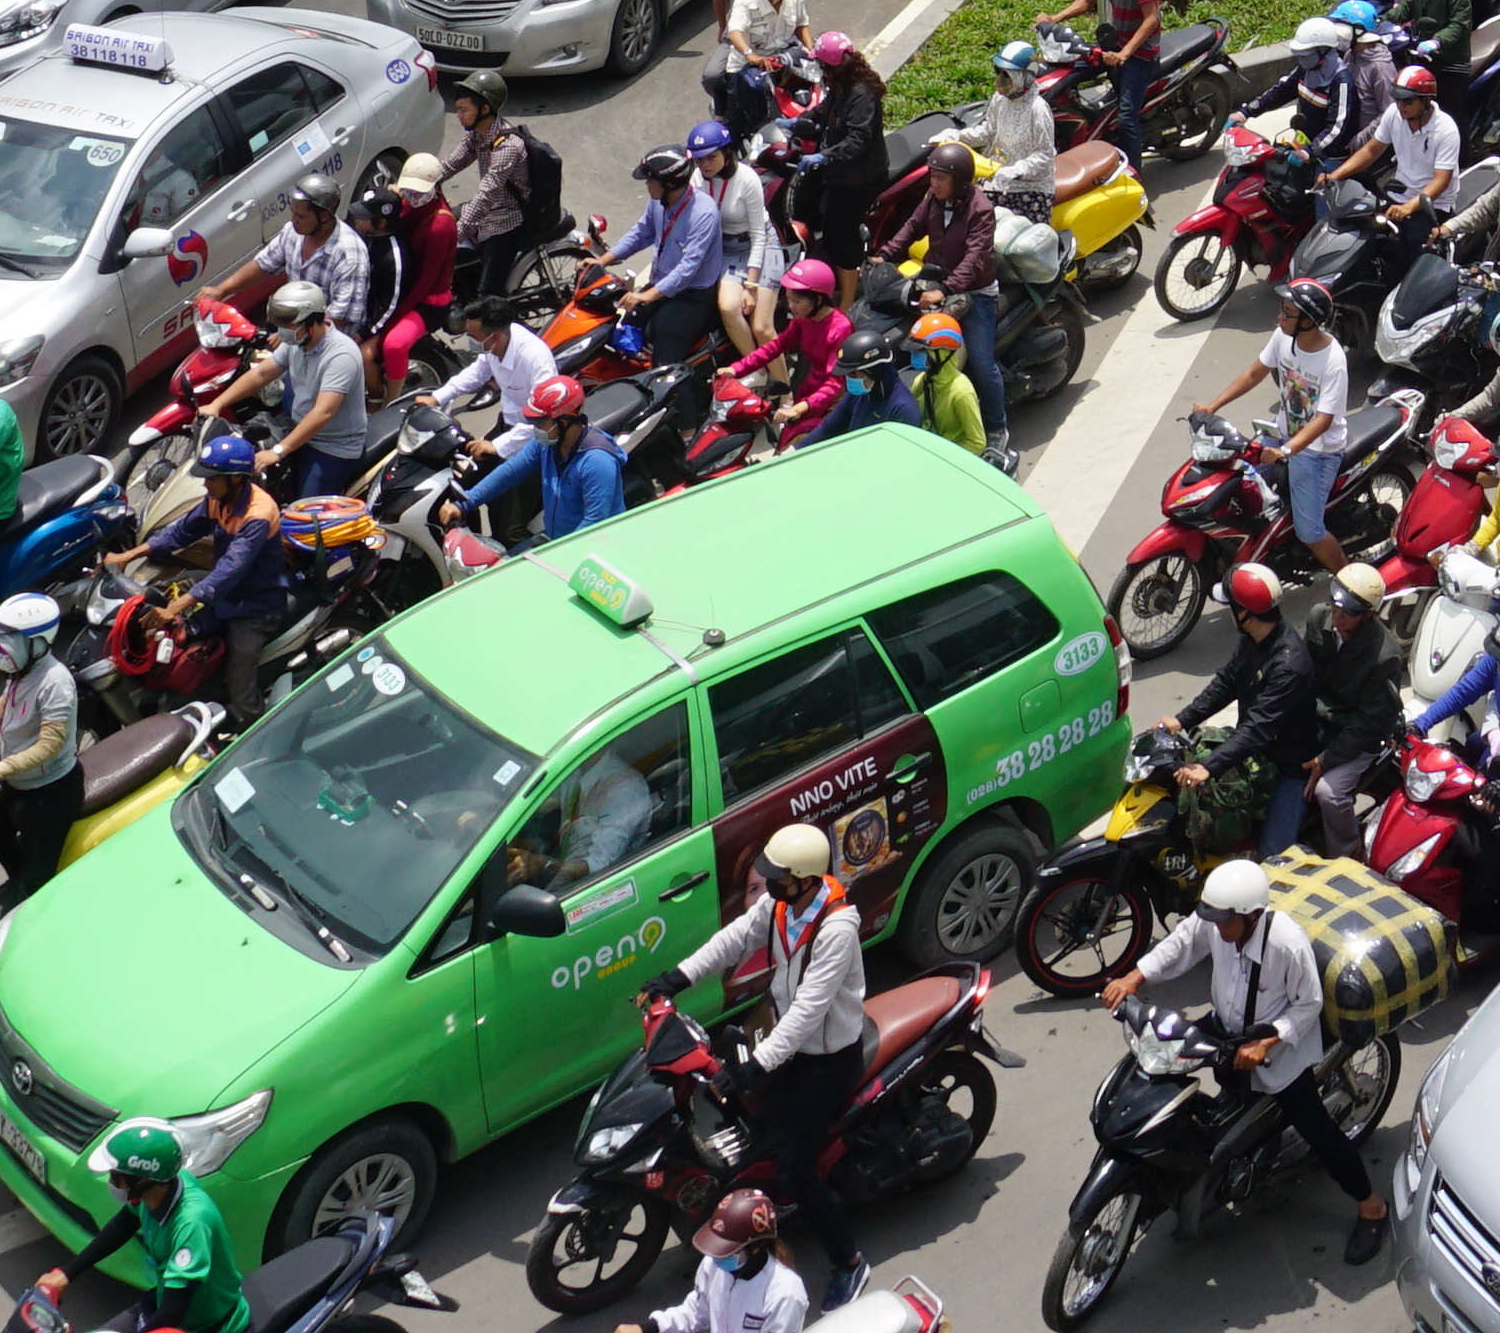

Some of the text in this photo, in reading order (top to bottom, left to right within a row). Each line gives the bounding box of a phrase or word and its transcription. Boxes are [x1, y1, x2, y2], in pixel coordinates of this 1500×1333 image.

[67, 29, 110, 48] SAIGON
[132, 39, 154, 54] TAXI
[96, 112, 136, 130] TAXI
[90, 146, 120, 161] 650
[1063, 636, 1099, 670] 3133
[377, 667, 401, 691] 3133
[1028, 734, 1056, 766] 28
[1058, 721, 1086, 754] 28
[1088, 709, 1115, 738] 28
[834, 755, 879, 792] VITE
[127, 1155, 161, 1172] Grab
